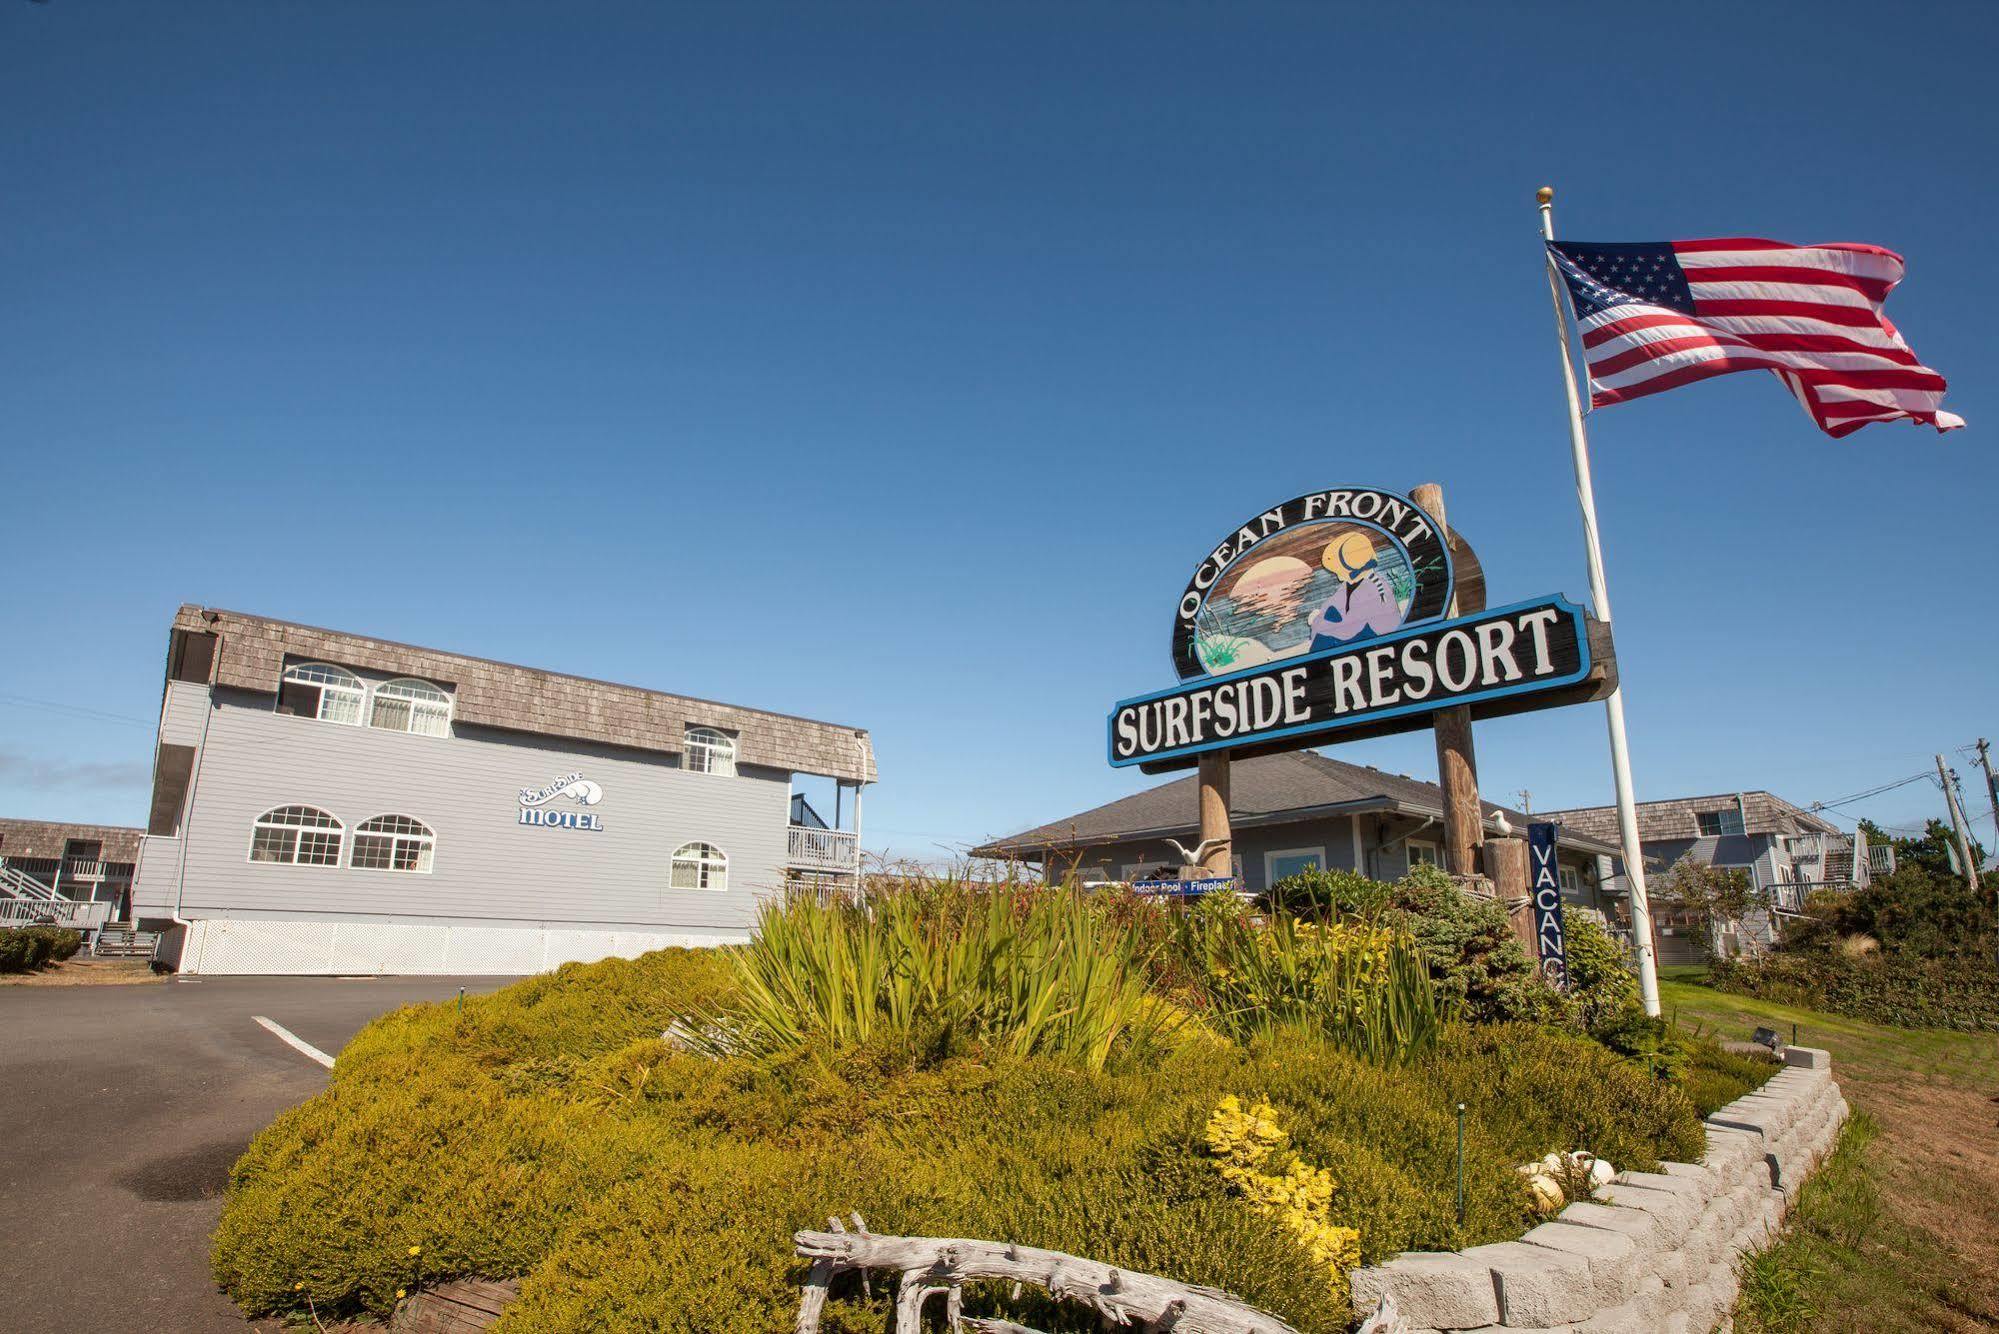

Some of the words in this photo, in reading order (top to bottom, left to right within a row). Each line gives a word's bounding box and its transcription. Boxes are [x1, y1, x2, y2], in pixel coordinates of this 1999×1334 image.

[1180, 505, 1286, 620] OCEAN
[1303, 490, 1432, 547] FRONT
[1116, 667, 1312, 757] SURFSIDE
[1330, 608, 1560, 715] RESORT
[519, 807, 604, 832] MOTEL
[1161, 882, 1181, 892] Pool
